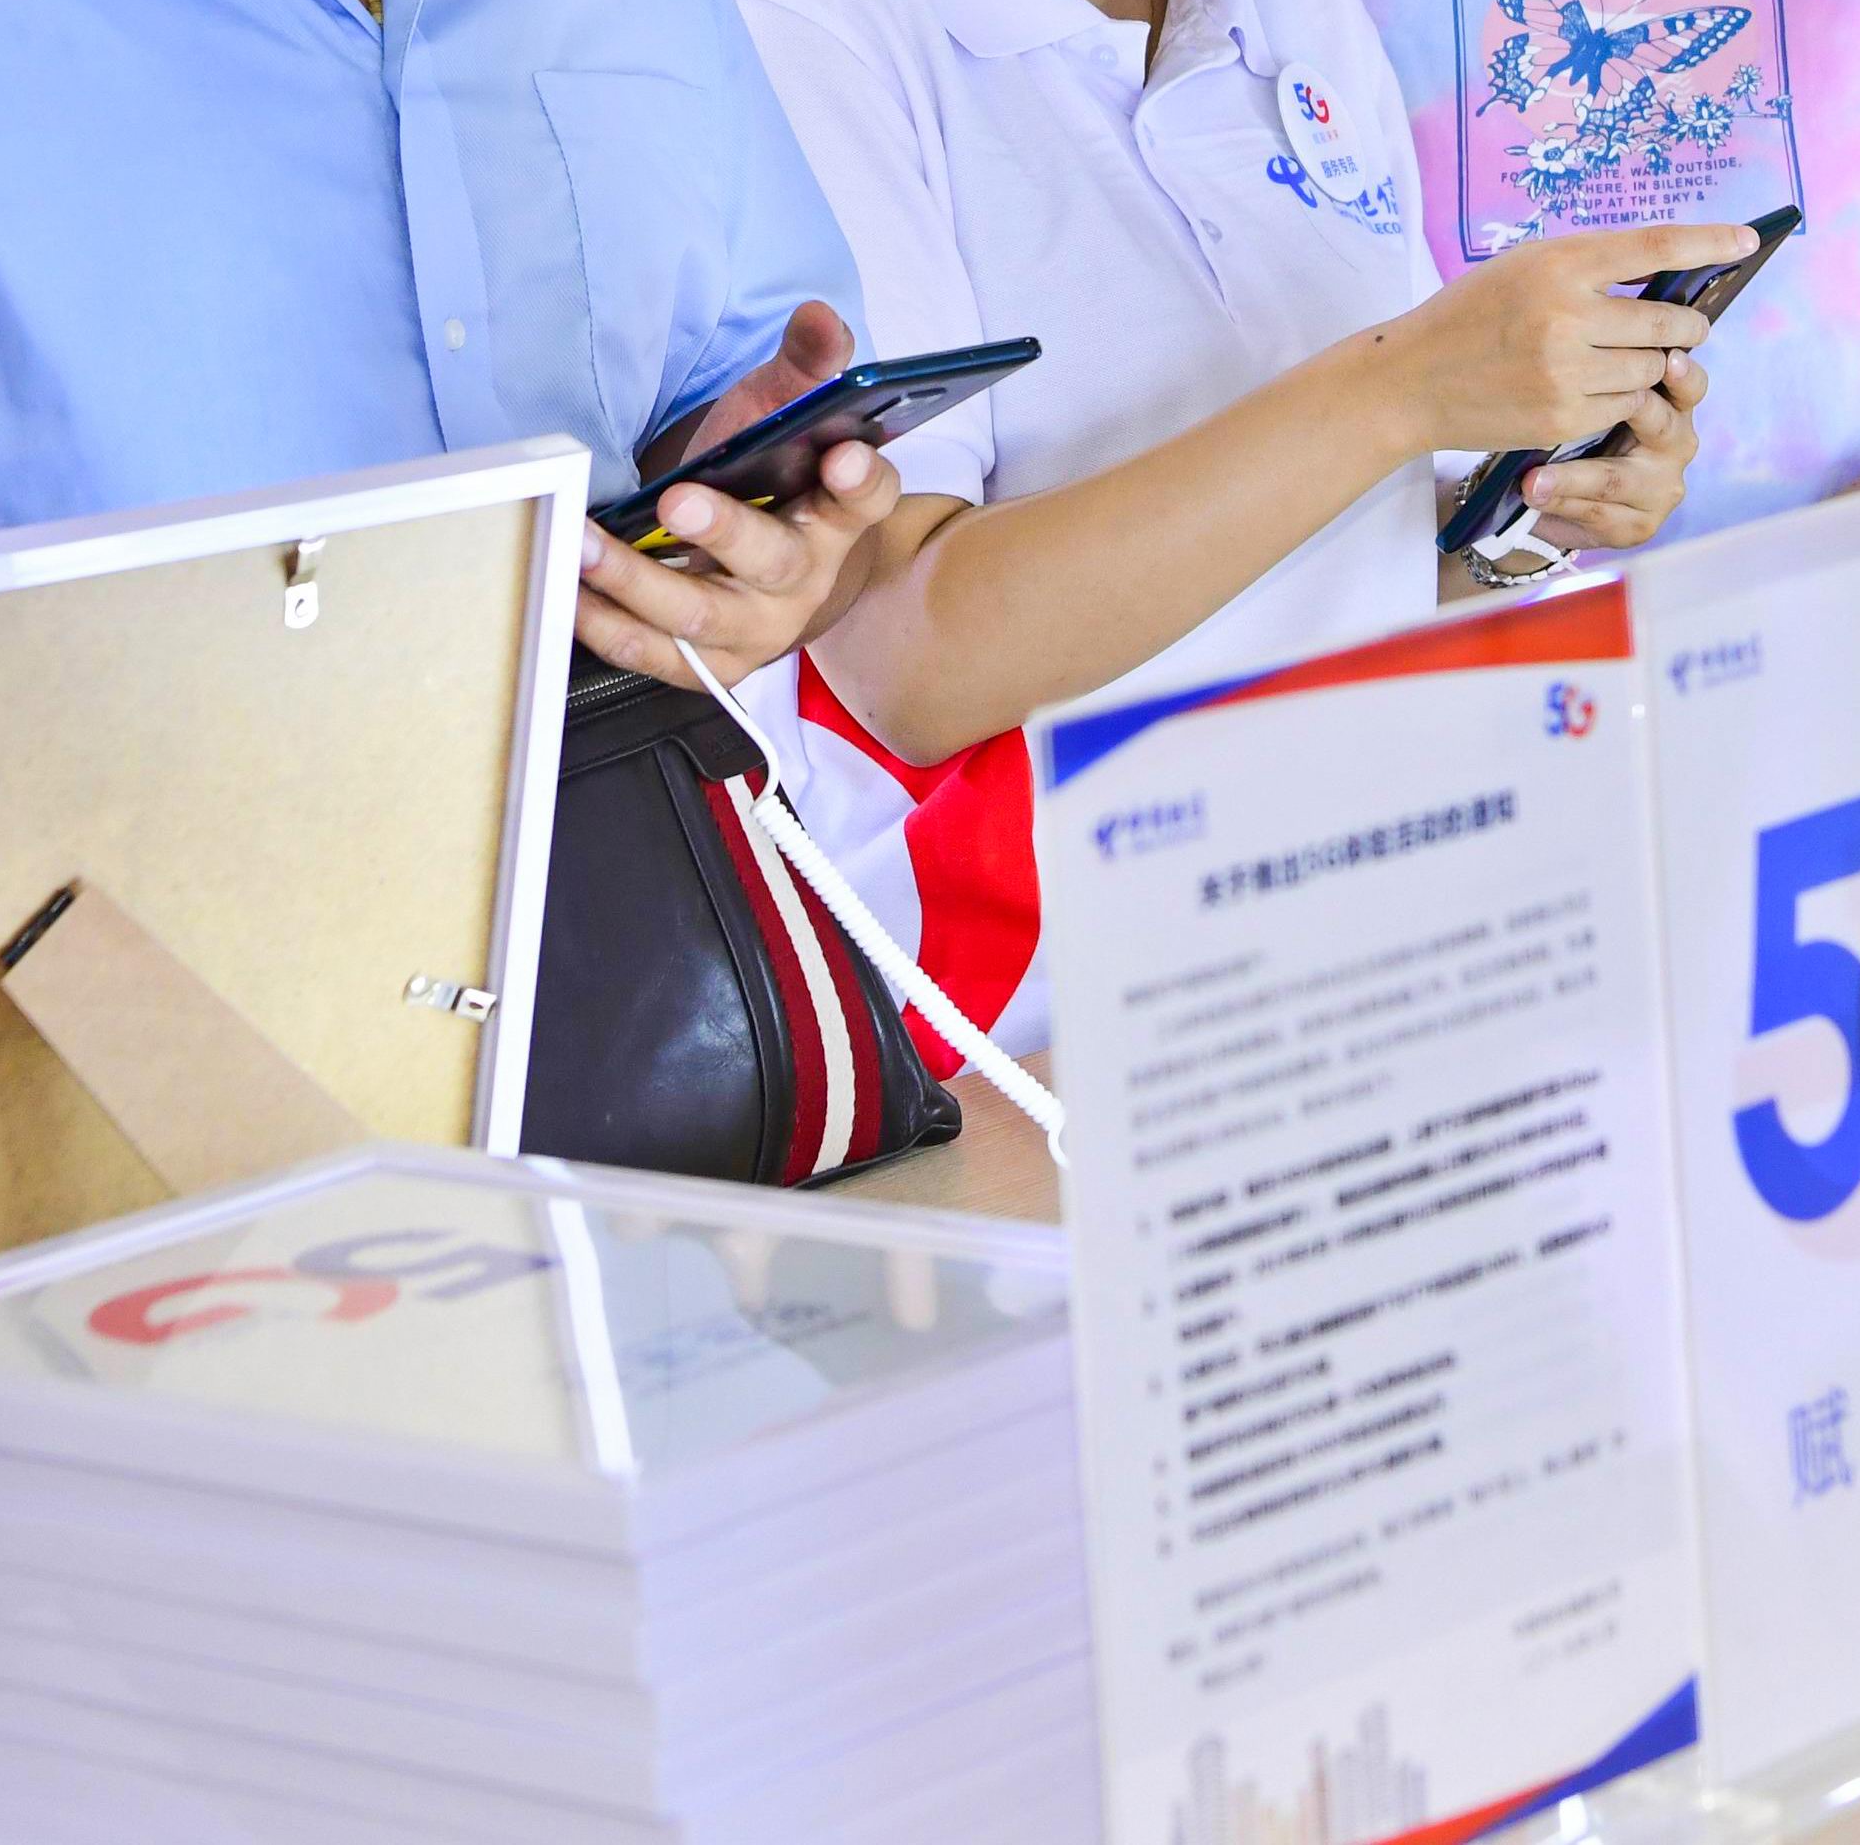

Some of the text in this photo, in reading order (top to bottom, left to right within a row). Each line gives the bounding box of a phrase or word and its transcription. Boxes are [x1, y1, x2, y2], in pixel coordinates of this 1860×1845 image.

[1293, 83, 1330, 124] 5G
[1633, 181, 1646, 191] IN
[1584, 199, 1602, 210] UP
[1607, 197, 1623, 208] AT
[1630, 195, 1657, 206] THE
[1663, 192, 1690, 204] SKY
[1696, 190, 1705, 201] &
[1571, 208, 1676, 226] CONTEMPLATE
[1542, 681, 1598, 739] 5G
